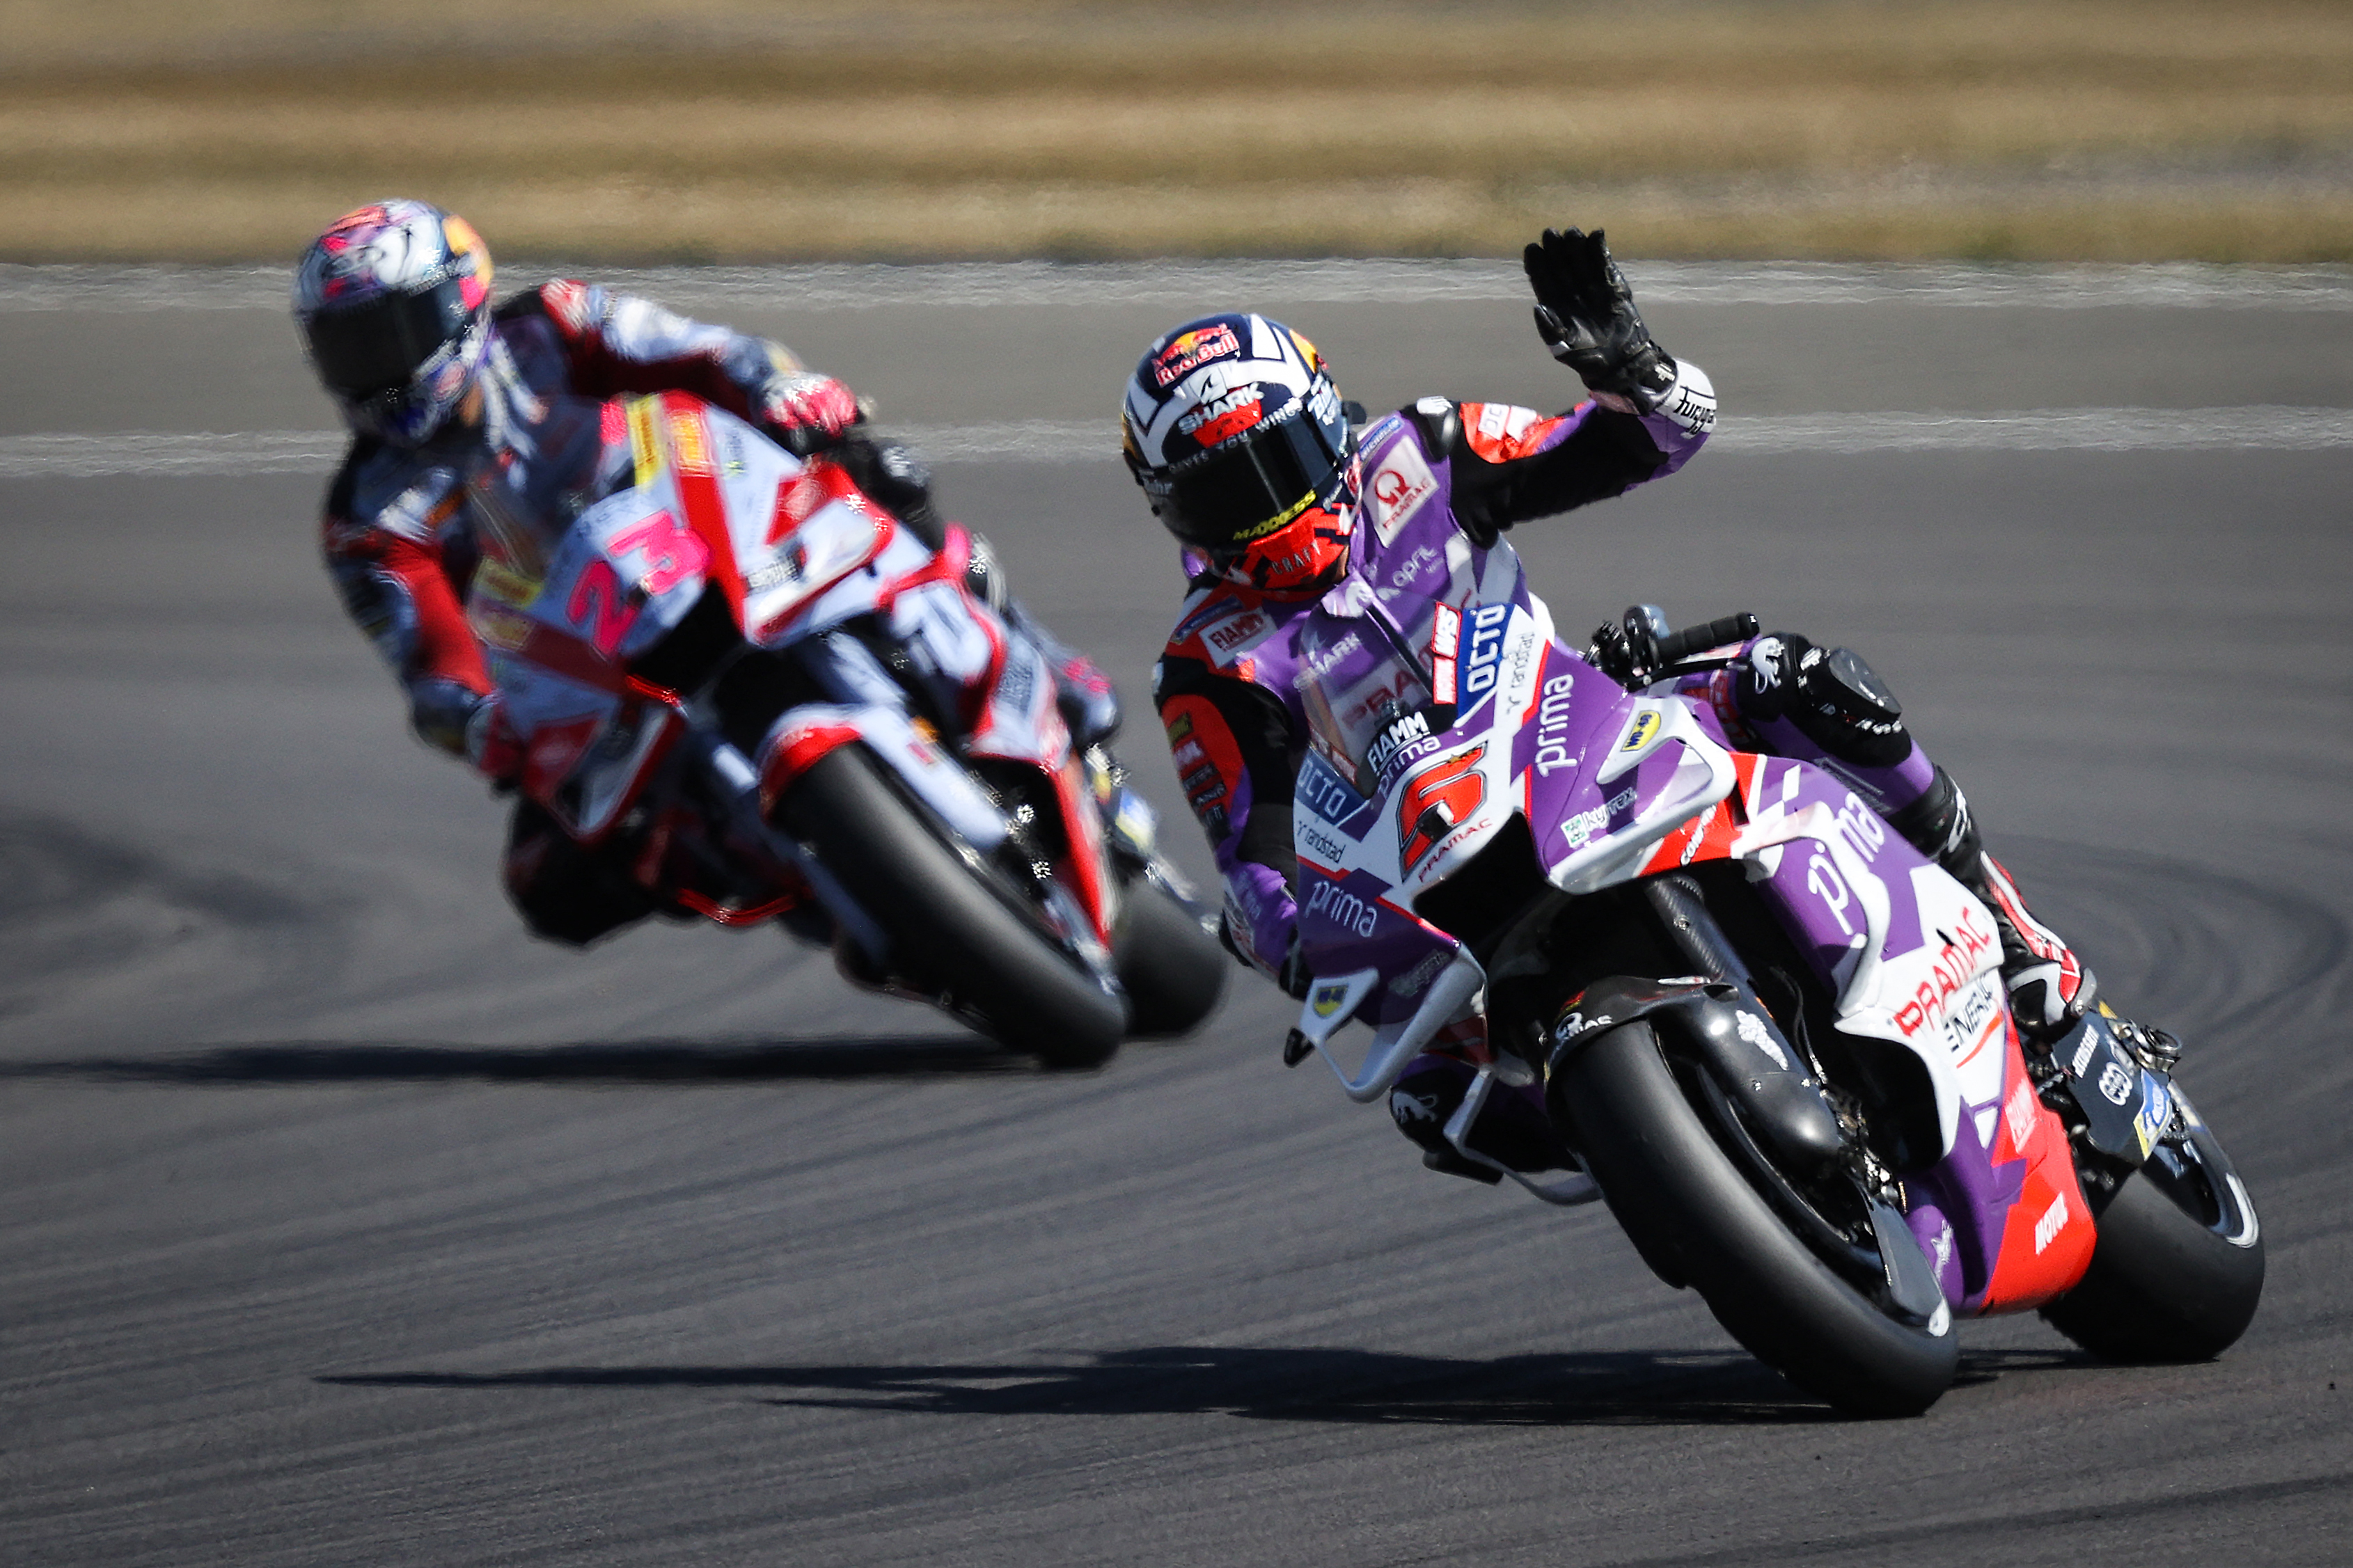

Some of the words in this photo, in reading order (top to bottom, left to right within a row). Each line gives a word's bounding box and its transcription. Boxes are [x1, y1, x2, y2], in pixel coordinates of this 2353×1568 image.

[1155, 358, 1197, 388] Red
[1196, 332, 1241, 364] Bull
[1178, 382, 1265, 435] SHARK
[1255, 397, 1303, 433] WINGS
[565, 509, 714, 658] 23
[1292, 631, 1361, 690] SHARK
[1467, 604, 1506, 693] OCTO
[1367, 711, 1429, 773] FIAMM
[1535, 674, 1577, 777] prima
[1296, 759, 1348, 819] OCTO
[1377, 735, 1442, 800] prima
[1303, 833, 1347, 864] randstad
[1417, 817, 1493, 883] PRAMAC
[1305, 880, 1378, 938] prima
